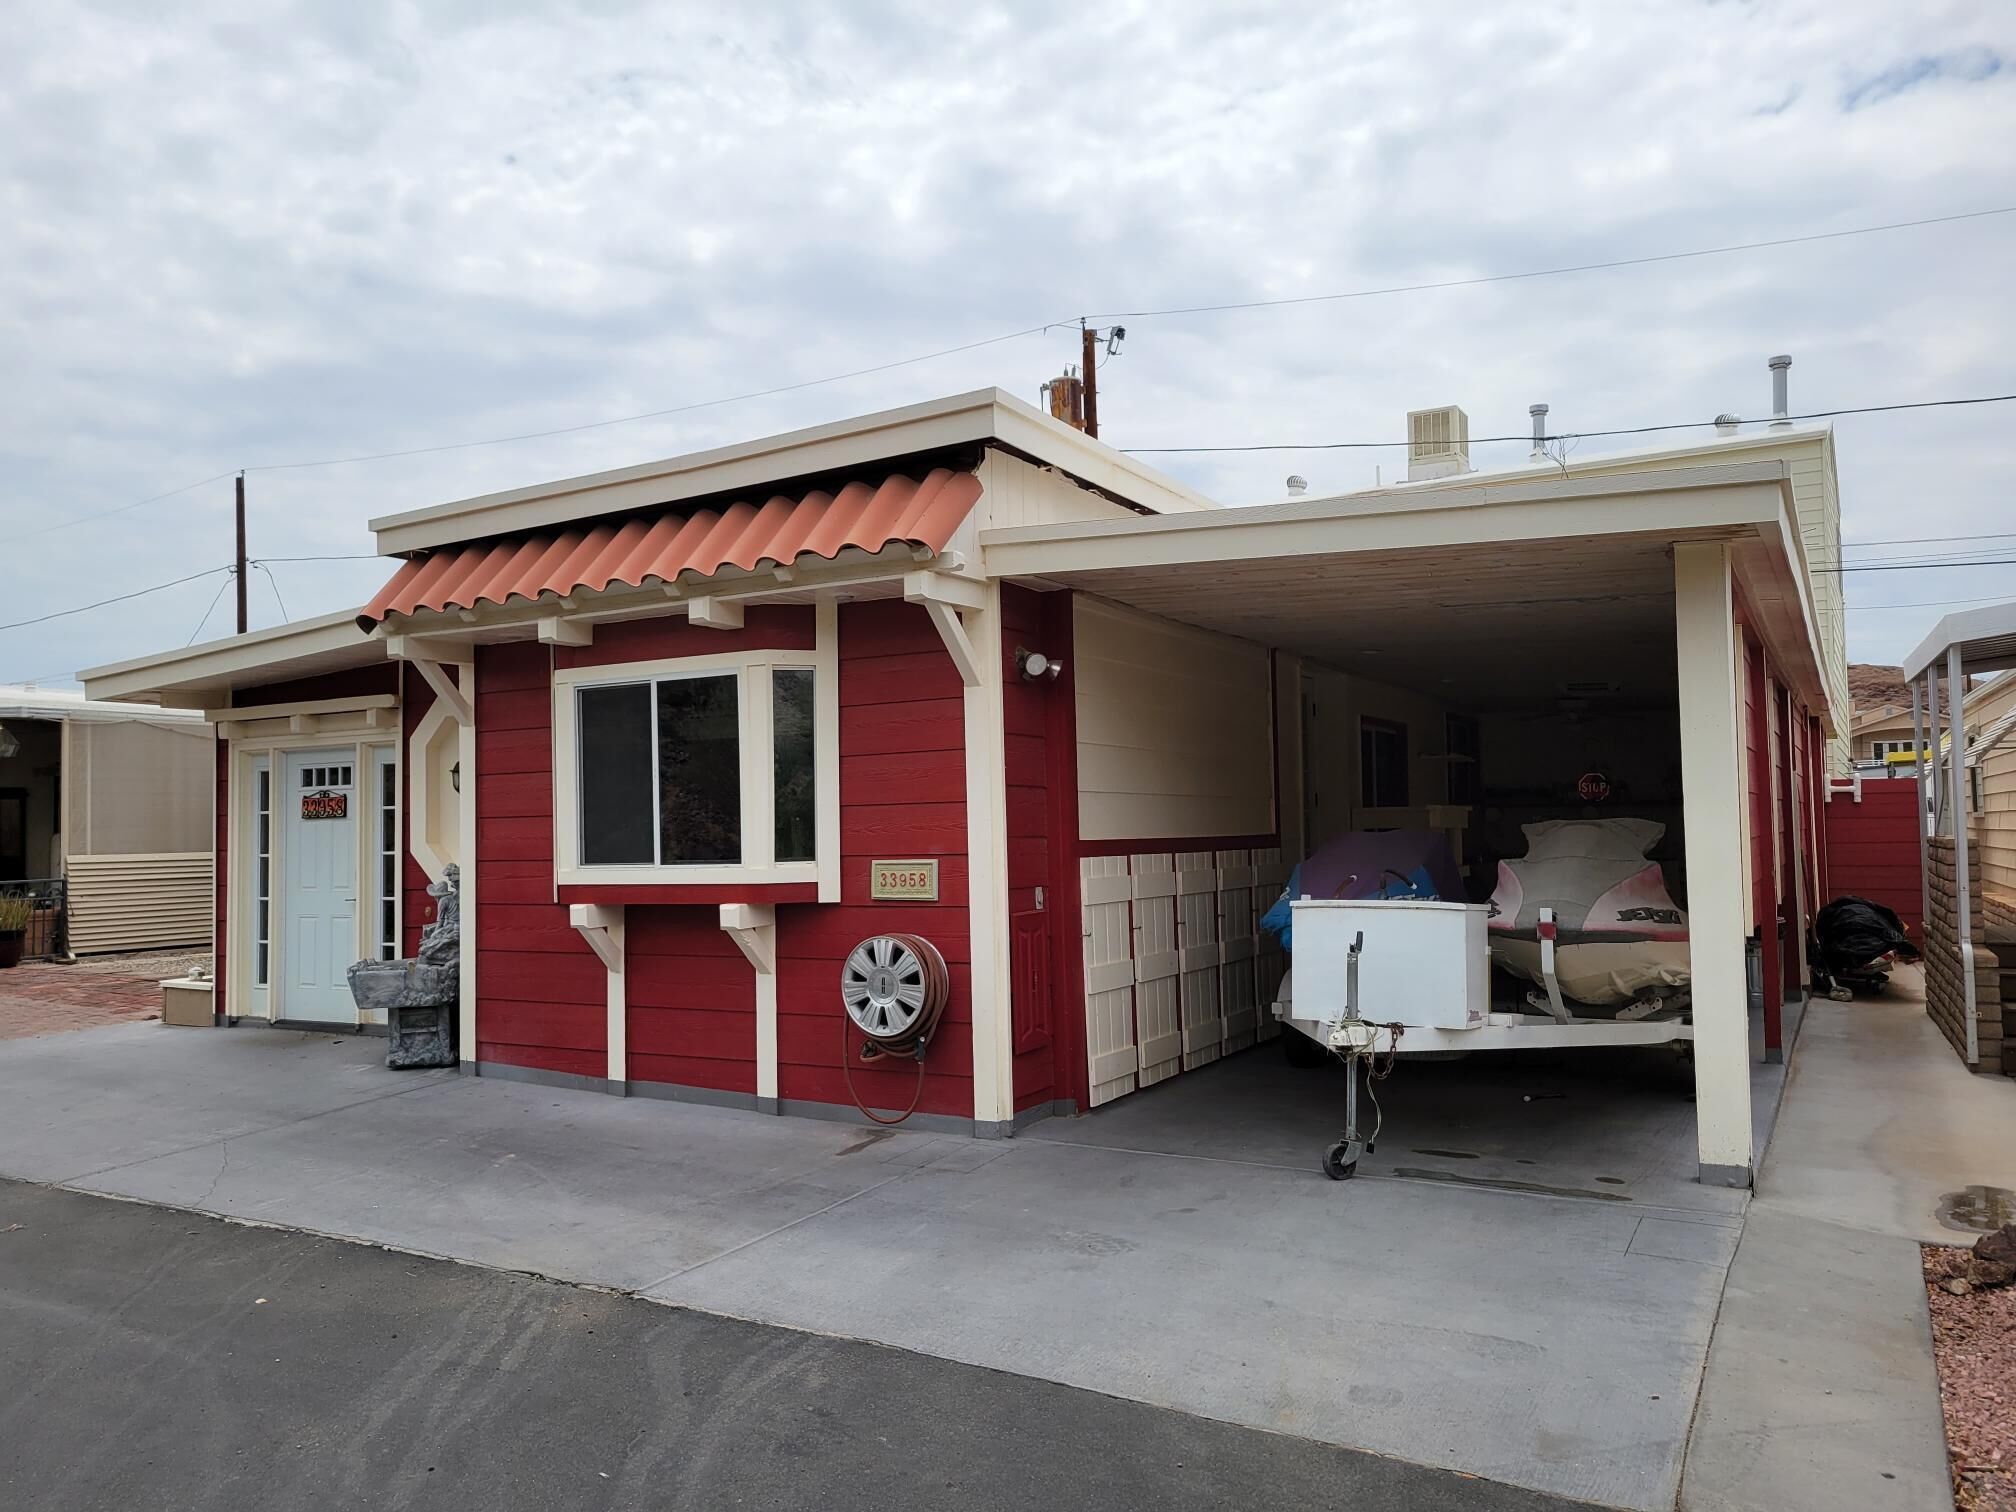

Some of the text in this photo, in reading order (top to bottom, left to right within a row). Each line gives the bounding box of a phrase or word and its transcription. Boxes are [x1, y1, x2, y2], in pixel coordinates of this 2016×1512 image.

[1581, 782, 1607, 793] STOP
[303, 799, 344, 817] 33958
[880, 872, 926, 888] 33958
